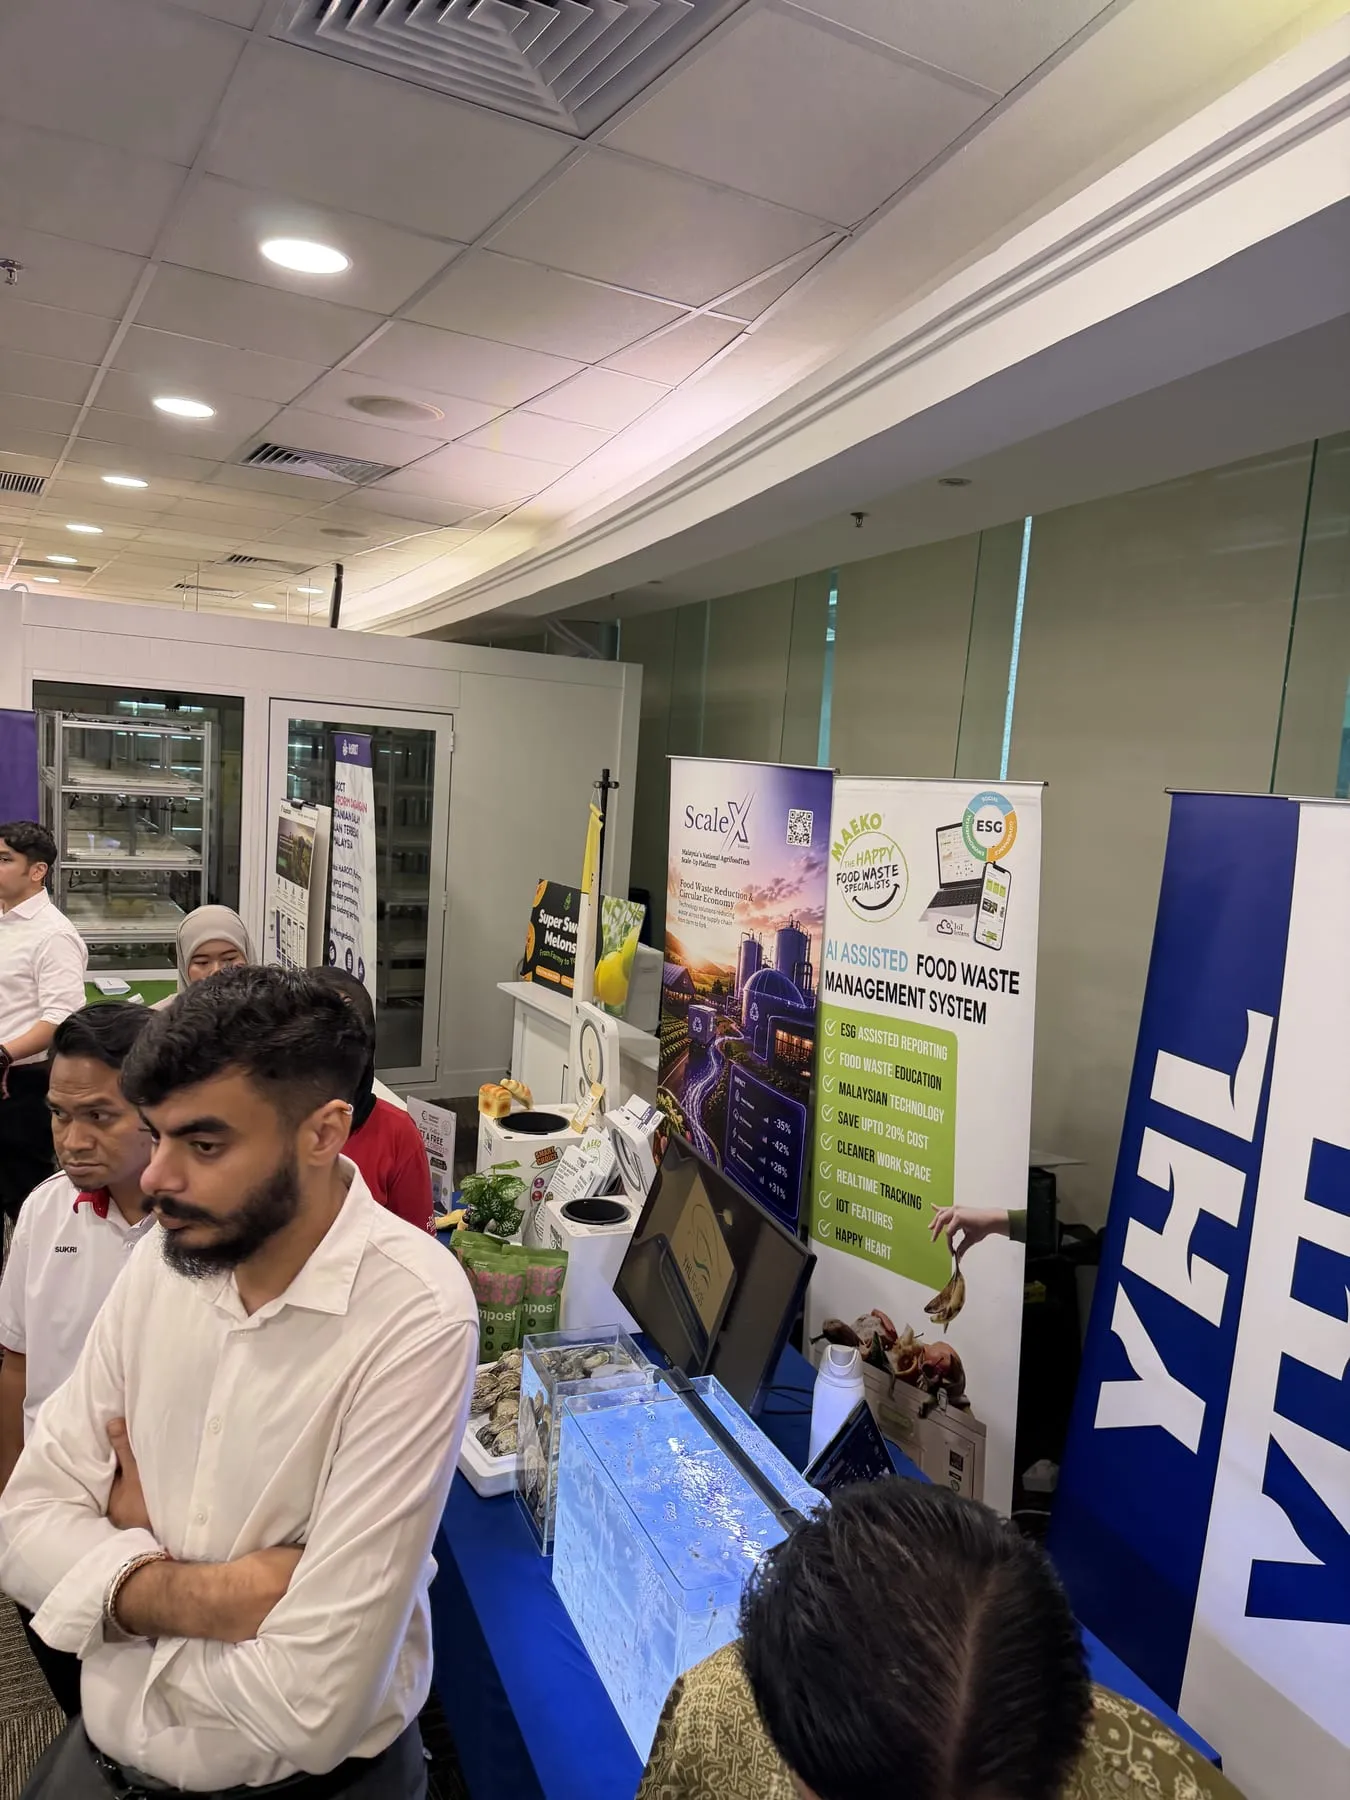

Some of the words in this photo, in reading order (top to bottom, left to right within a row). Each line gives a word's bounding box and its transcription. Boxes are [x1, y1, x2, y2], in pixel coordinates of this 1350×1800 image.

[831, 813, 882, 862] MAEKO
[976, 820, 1003, 833] ESG
[844, 860, 856, 868] THE
[856, 845, 895, 866] HAPPY
[836, 870, 860, 886] FOOD
[862, 864, 899, 880] WASTE
[844, 880, 890, 893] SPECIALISTS
[680, 880, 694, 890] Food
[696, 882, 713, 894] Waste
[715, 887, 747, 901] Reduction
[748, 892, 754, 902] &
[680, 889, 702, 901] Circular
[704, 894, 735, 909] Economy
[538, 908, 562, 929] Super
[544, 930, 577, 954] Melons
[826, 940, 838, 961] AI
[840, 943, 908, 972] ASSISTED
[917, 954, 957, 982] FOOD
[960, 962, 1020, 994] WASTE
[825, 970, 926, 1009] MANAGEMENT
[929, 990, 987, 1024] SYSTEM
[841, 1022, 856, 1038] ESG
[858, 1026, 899, 1048] ASSISTED
[901, 1035, 948, 1060] REPORTING
[840, 1052, 861, 1069] FOOD
[864, 1057, 893, 1078] WASTE
[895, 1065, 942, 1091] EDUCATION
[839, 1081, 888, 1106] MALAYSIAN
[890, 1094, 944, 1124] TECHNOLOGY
[774, 1118, 791, 1135] -35%
[838, 1111, 859, 1128] SAVE
[861, 1116, 883, 1135] UPTO
[886, 1124, 905, 1142] 20%
[907, 1130, 929, 1150] COST
[772, 1141, 789, 1156] -42%
[837, 1140, 875, 1163] CLEANER
[877, 1151, 902, 1172] WORK
[904, 1161, 931, 1183] SPACE
[770, 1161, 788, 1178] +28%
[769, 1182, 786, 1200] +31%
[837, 1169, 878, 1194] REALTIME
[880, 1183, 922, 1210] TRACKING
[836, 1198, 850, 1214] IOT
[851, 1203, 893, 1230] FEATURES
[836, 1227, 863, 1248] HAPPY
[865, 1237, 892, 1260] HEART
[1094, 1009, 1274, 1455] YHL
